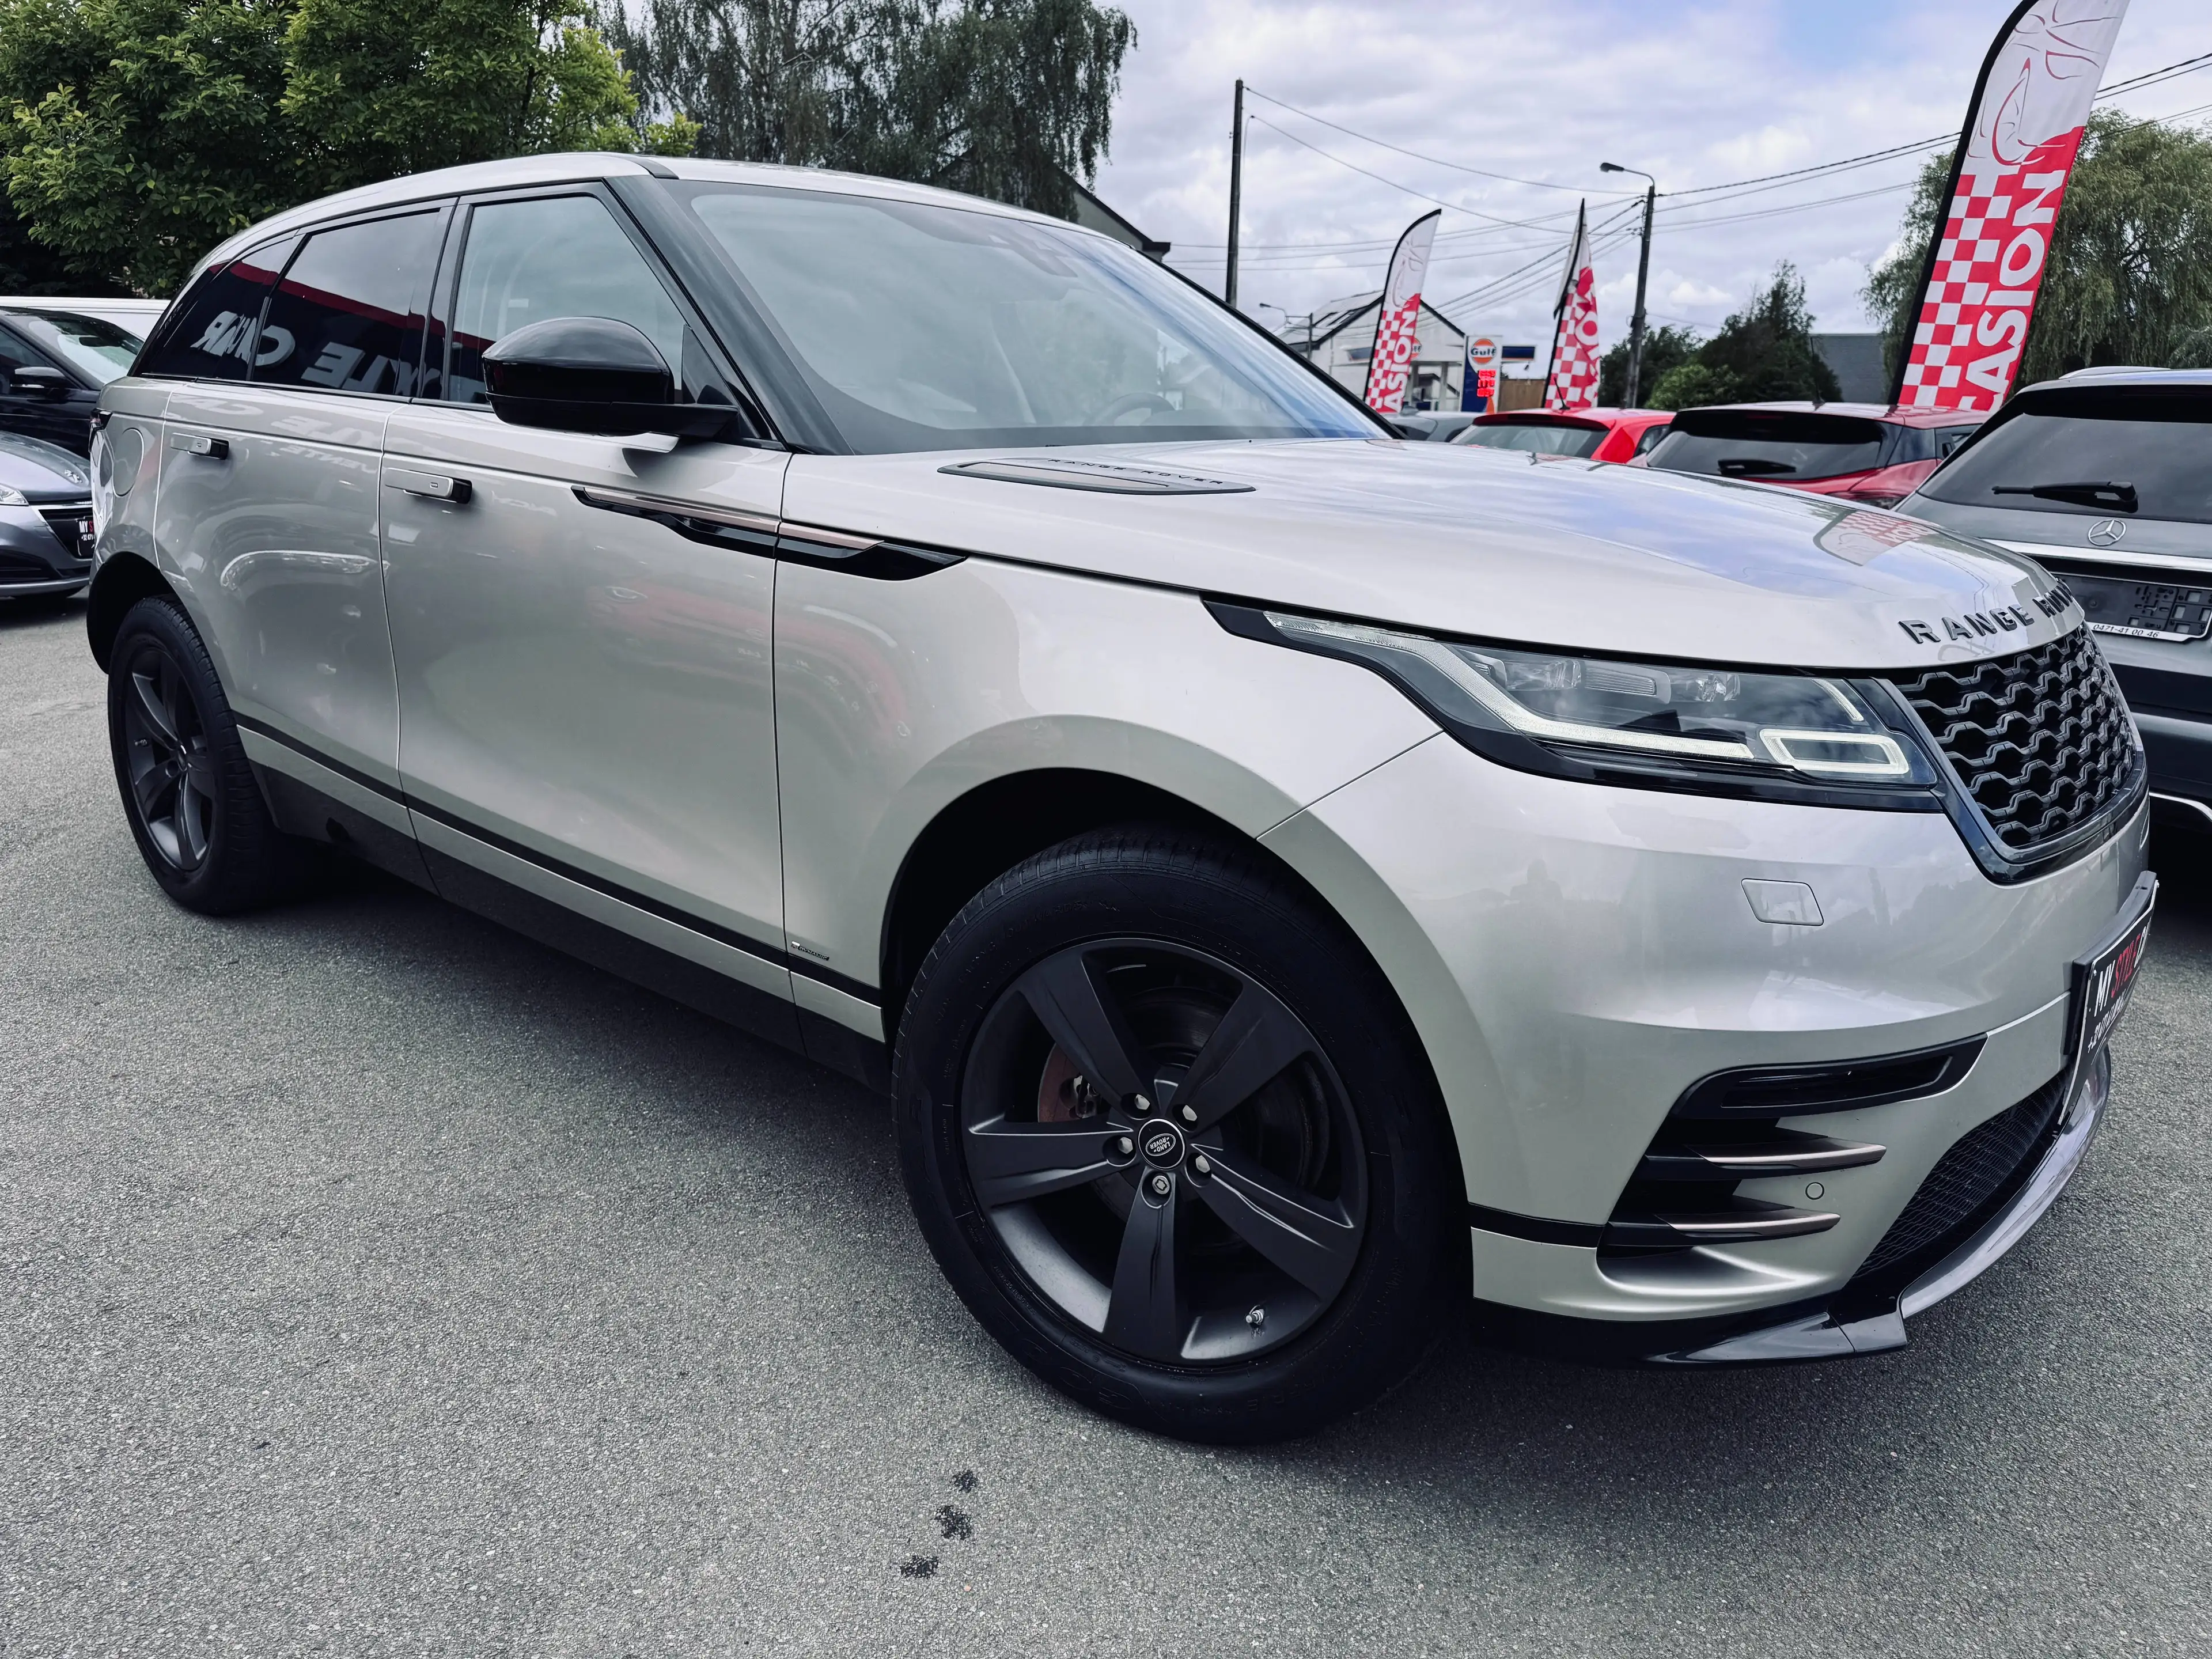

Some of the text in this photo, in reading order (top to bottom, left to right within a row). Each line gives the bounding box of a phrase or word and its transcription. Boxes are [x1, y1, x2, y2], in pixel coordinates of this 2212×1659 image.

[1471, 347, 1496, 356] Gulf
[1047, 459, 1224, 485] RANGE ROVER
[79, 521, 88, 533] MY
[1898, 605, 2035, 644] RANGE
[2093, 624, 2128, 634] 0471-41
[2131, 628, 2143, 637] 00
[2094, 959, 2116, 1017] MY
[2111, 933, 2141, 998] STYLE
[1150, 1137, 1166, 1149] ROVER
[1156, 1141, 1171, 1152] LAND
